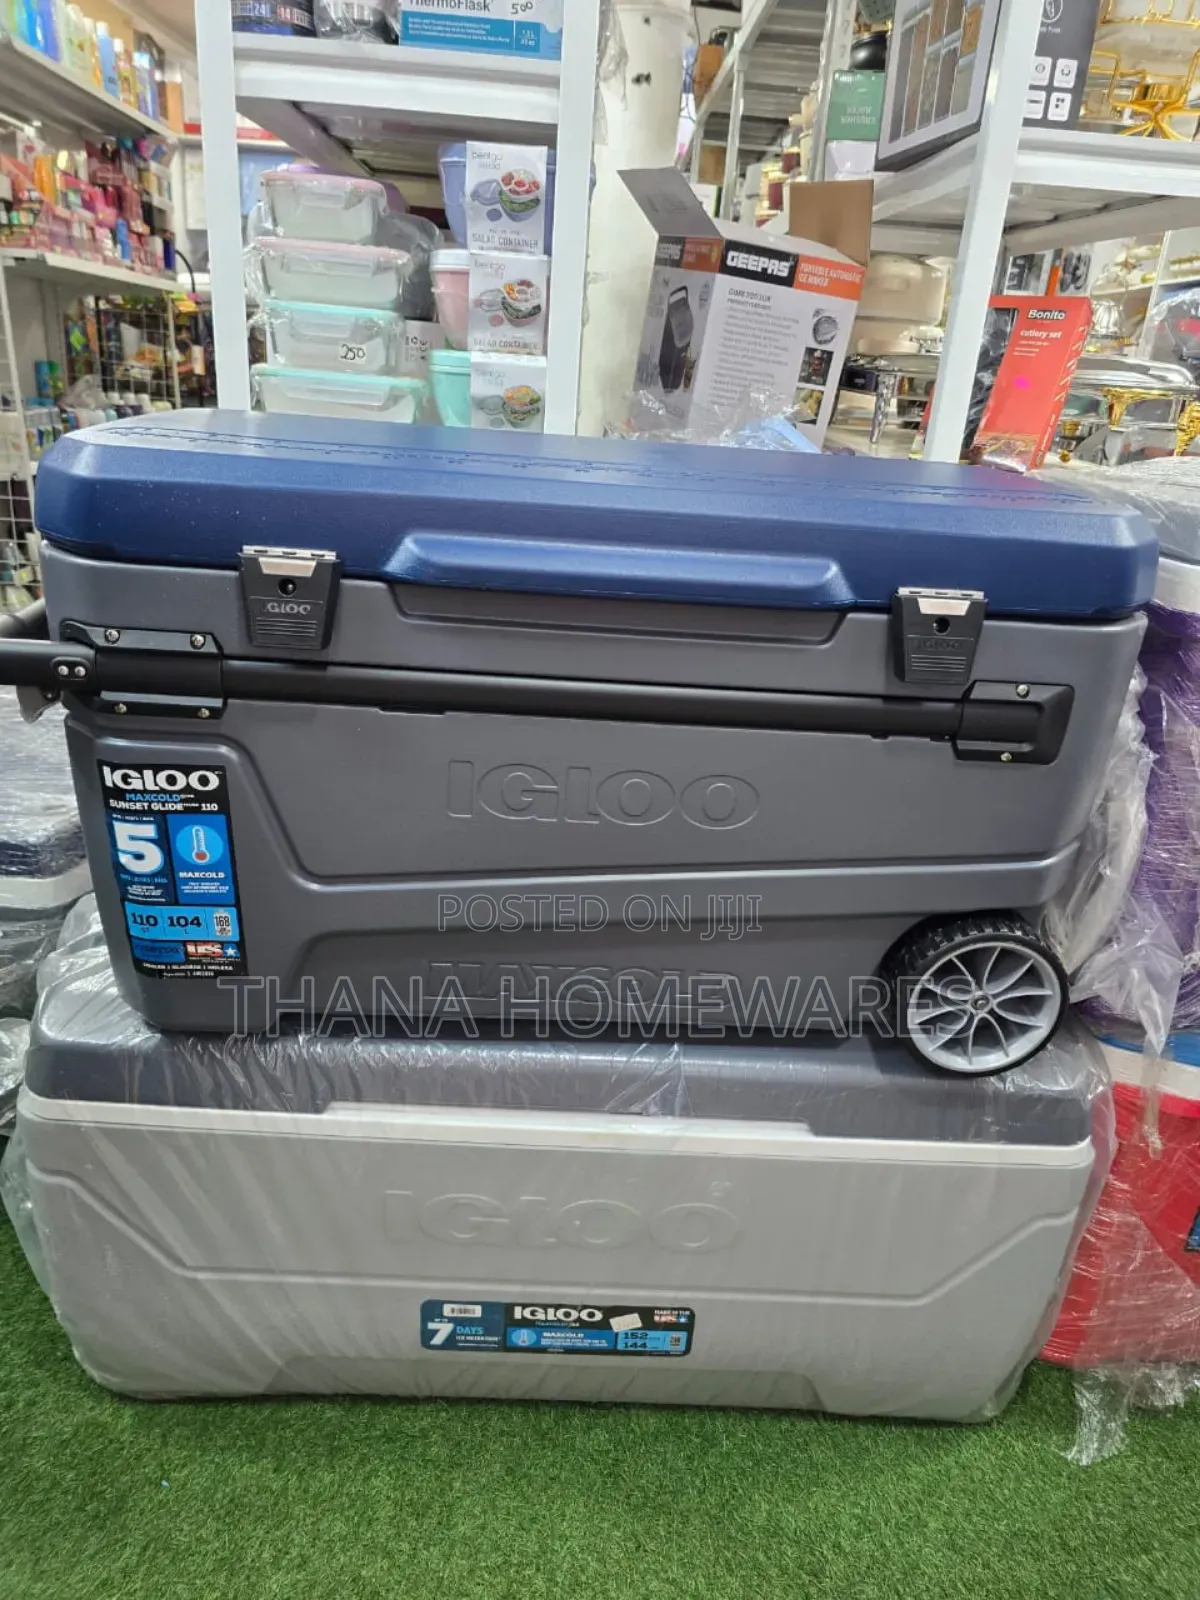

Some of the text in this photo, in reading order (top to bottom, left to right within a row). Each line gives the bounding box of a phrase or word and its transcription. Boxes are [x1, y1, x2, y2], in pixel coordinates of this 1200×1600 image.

[726, 250, 792, 277] GEEPAS
[1027, 309, 1066, 320] Bonito
[340, 343, 366, 362] 250
[102, 765, 220, 791] IGLOO
[125, 792, 181, 802] MAXCOLD
[446, 759, 760, 831] IGLOO
[109, 799, 219, 811] SUNSET GLIDE 110
[112, 819, 164, 875] 5
[179, 871, 226, 879] MAXCOLD
[131, 912, 231, 928] 110 104 168
[513, 1305, 603, 1322] IGLOO
[427, 1322, 455, 1345] 7
[456, 1325, 484, 1335] DAYS
[622, 1331, 649, 1340] 152
[622, 1341, 649, 1350] 144
